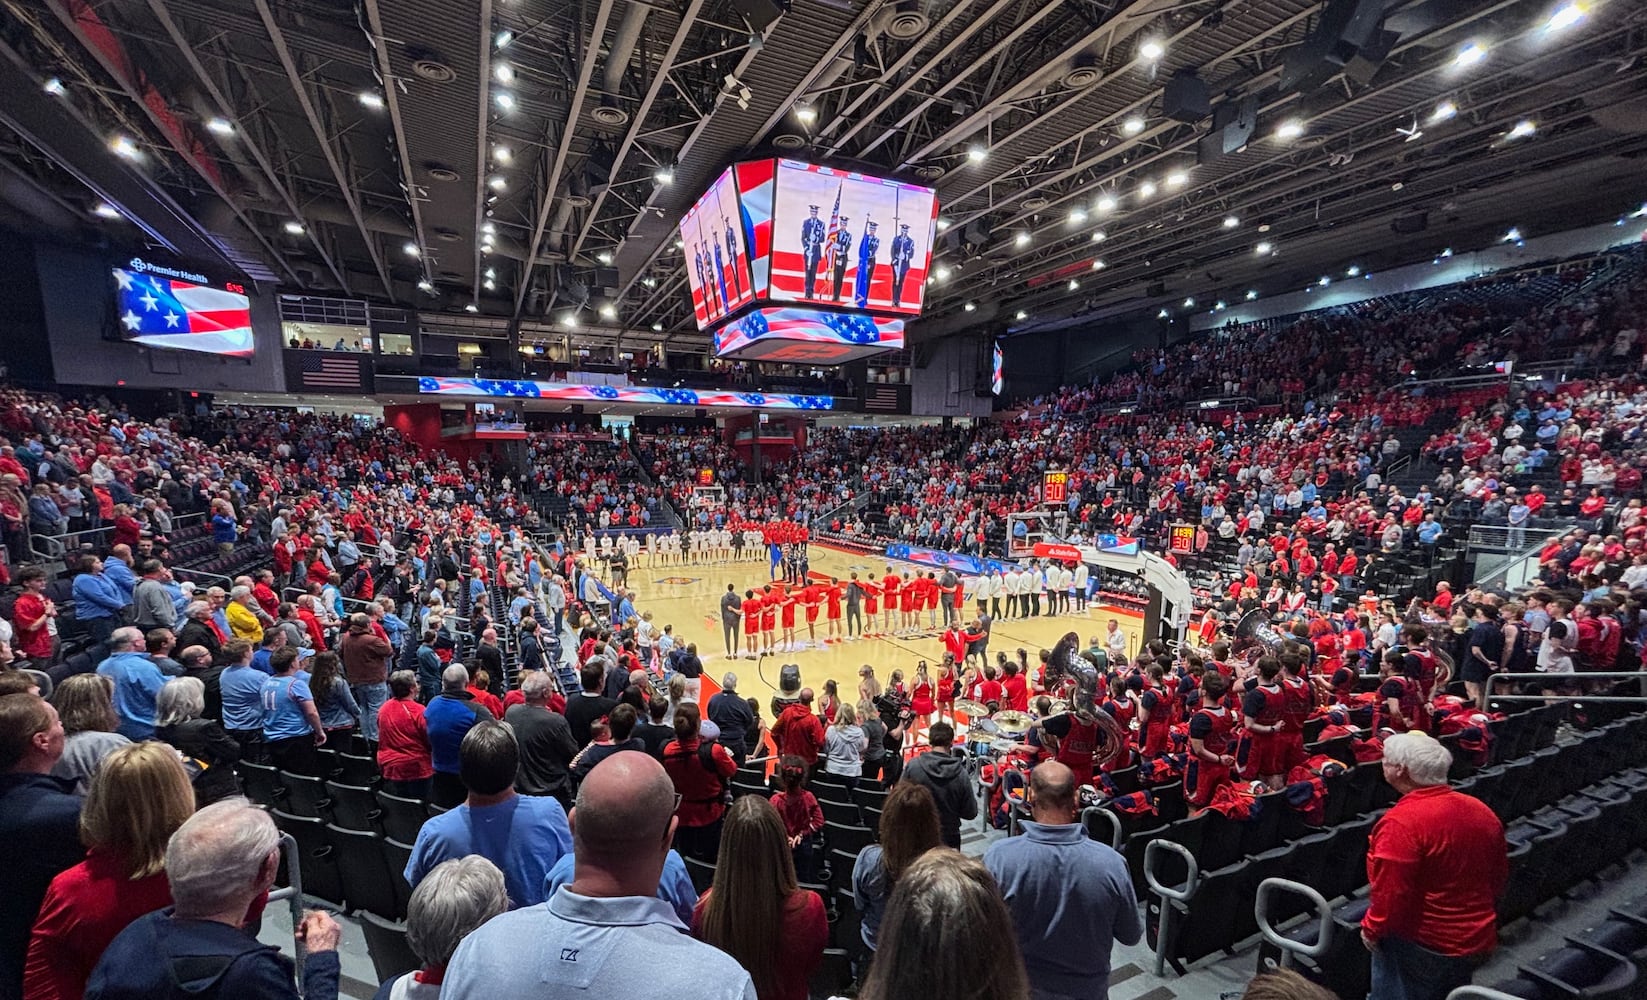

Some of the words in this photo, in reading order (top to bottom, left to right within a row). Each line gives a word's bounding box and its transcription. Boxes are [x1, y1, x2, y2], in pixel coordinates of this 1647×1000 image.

[146, 263, 180, 278] Premier
[180, 270, 208, 284] Health
[1046, 484, 1063, 500] 30
[1174, 537, 1188, 549] 30
[264, 690, 276, 710] 11
